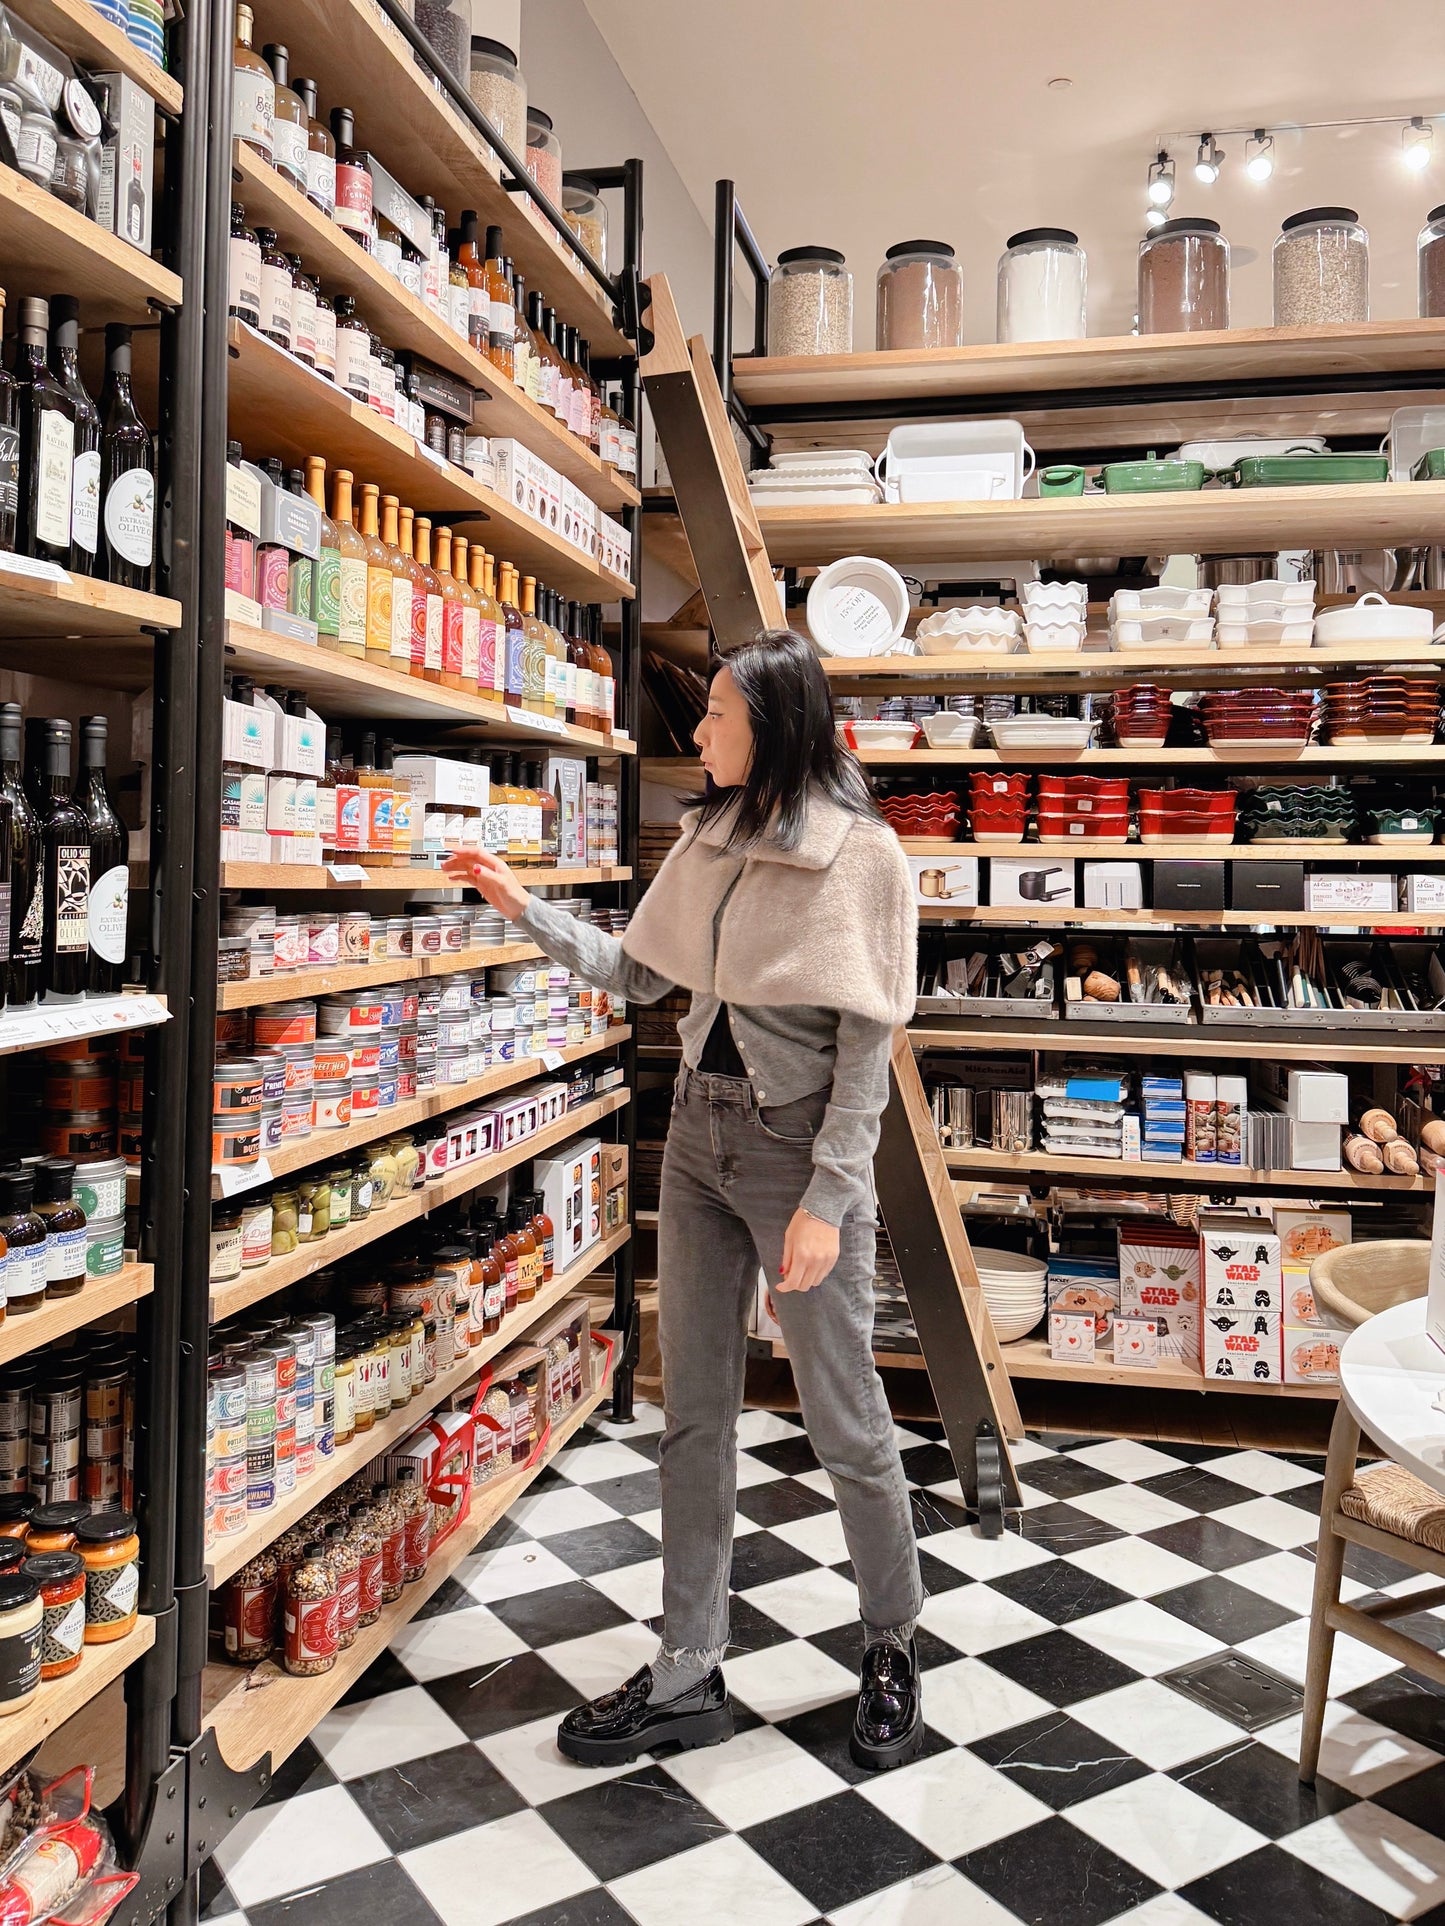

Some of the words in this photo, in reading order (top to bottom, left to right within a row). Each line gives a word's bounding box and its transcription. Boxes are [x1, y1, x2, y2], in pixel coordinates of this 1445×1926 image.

[852, 590, 866, 606] OFF
[61, 848, 78, 859] OLIO
[965, 1064, 1026, 1075] KitchenAid
[265, 1080, 281, 1090] PRIME
[216, 1237, 238, 1251] BURGER
[1225, 1264, 1260, 1273] STAR
[1226, 1272, 1260, 1281] WARS
[1141, 1286, 1179, 1297] STAR
[1141, 1295, 1179, 1306] WARS
[1225, 1335, 1260, 1344] STAR
[1226, 1343, 1260, 1352] WARS
[299, 1454, 313, 1463] TACO
